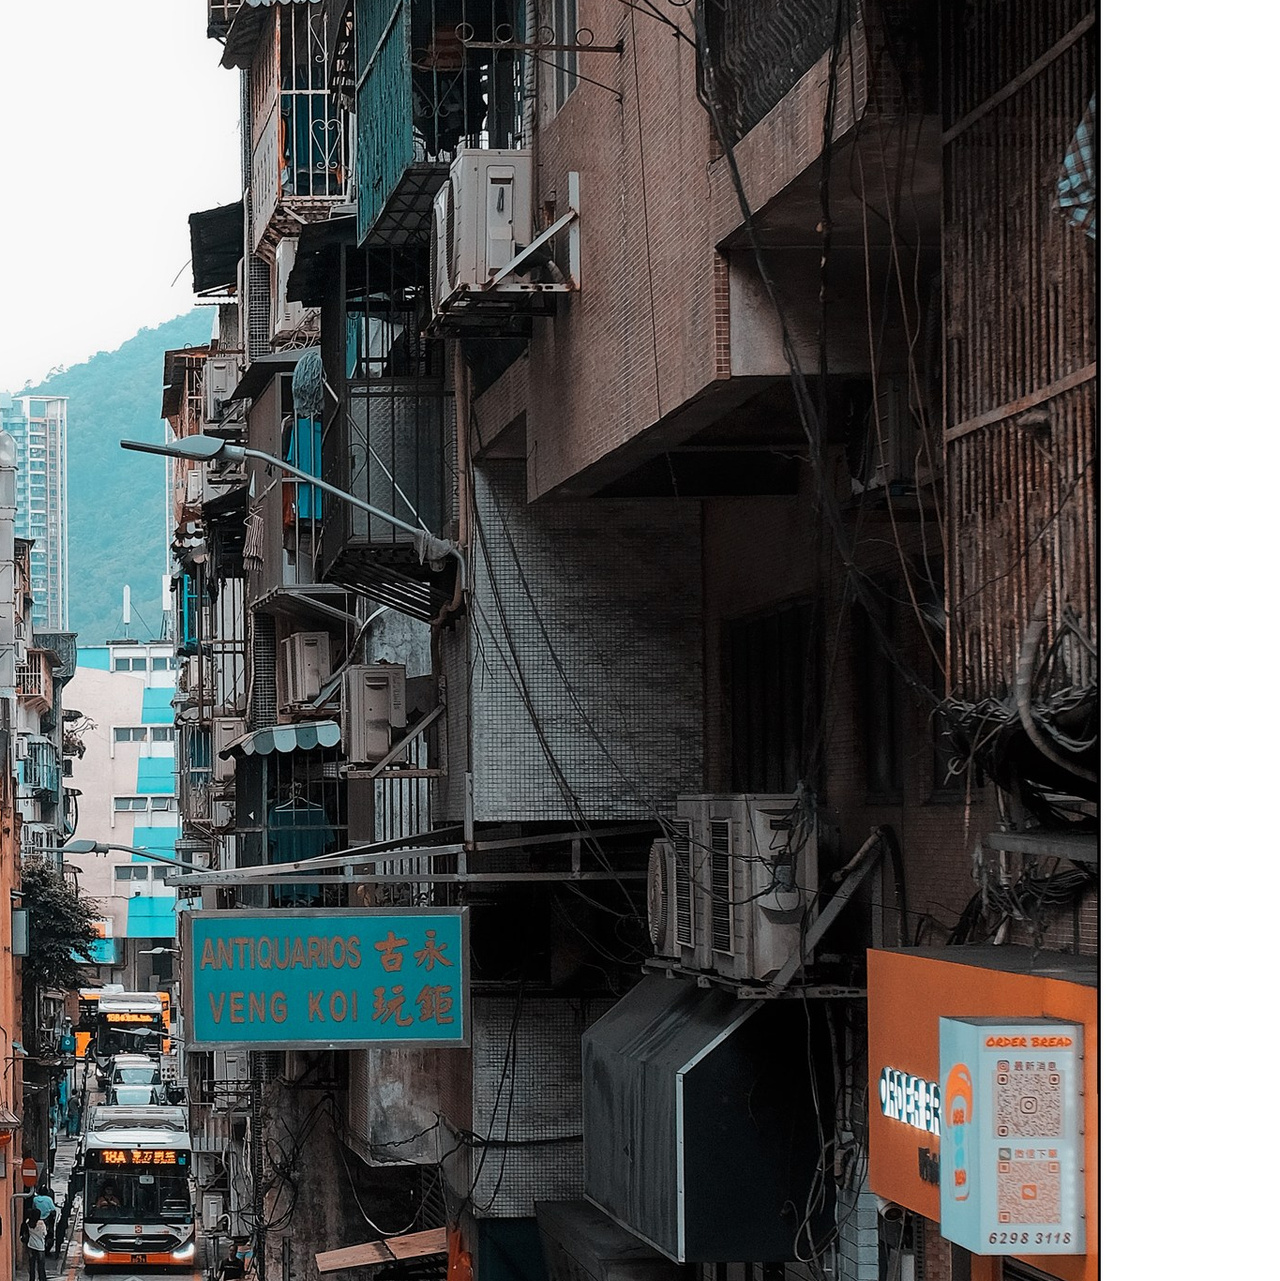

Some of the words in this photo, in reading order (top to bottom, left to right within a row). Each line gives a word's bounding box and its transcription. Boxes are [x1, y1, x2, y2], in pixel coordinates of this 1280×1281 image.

[200, 935, 362, 970] ANTIQUARIOS
[208, 990, 288, 1024] VENG
[308, 989, 358, 1023] KOI
[986, 1036, 1028, 1048] ORDER
[1030, 1036, 1073, 1048] BREAD
[102, 1151, 127, 1164] 18A
[988, 1232, 1030, 1245] 6298
[1034, 1232, 1072, 1245] 3118
